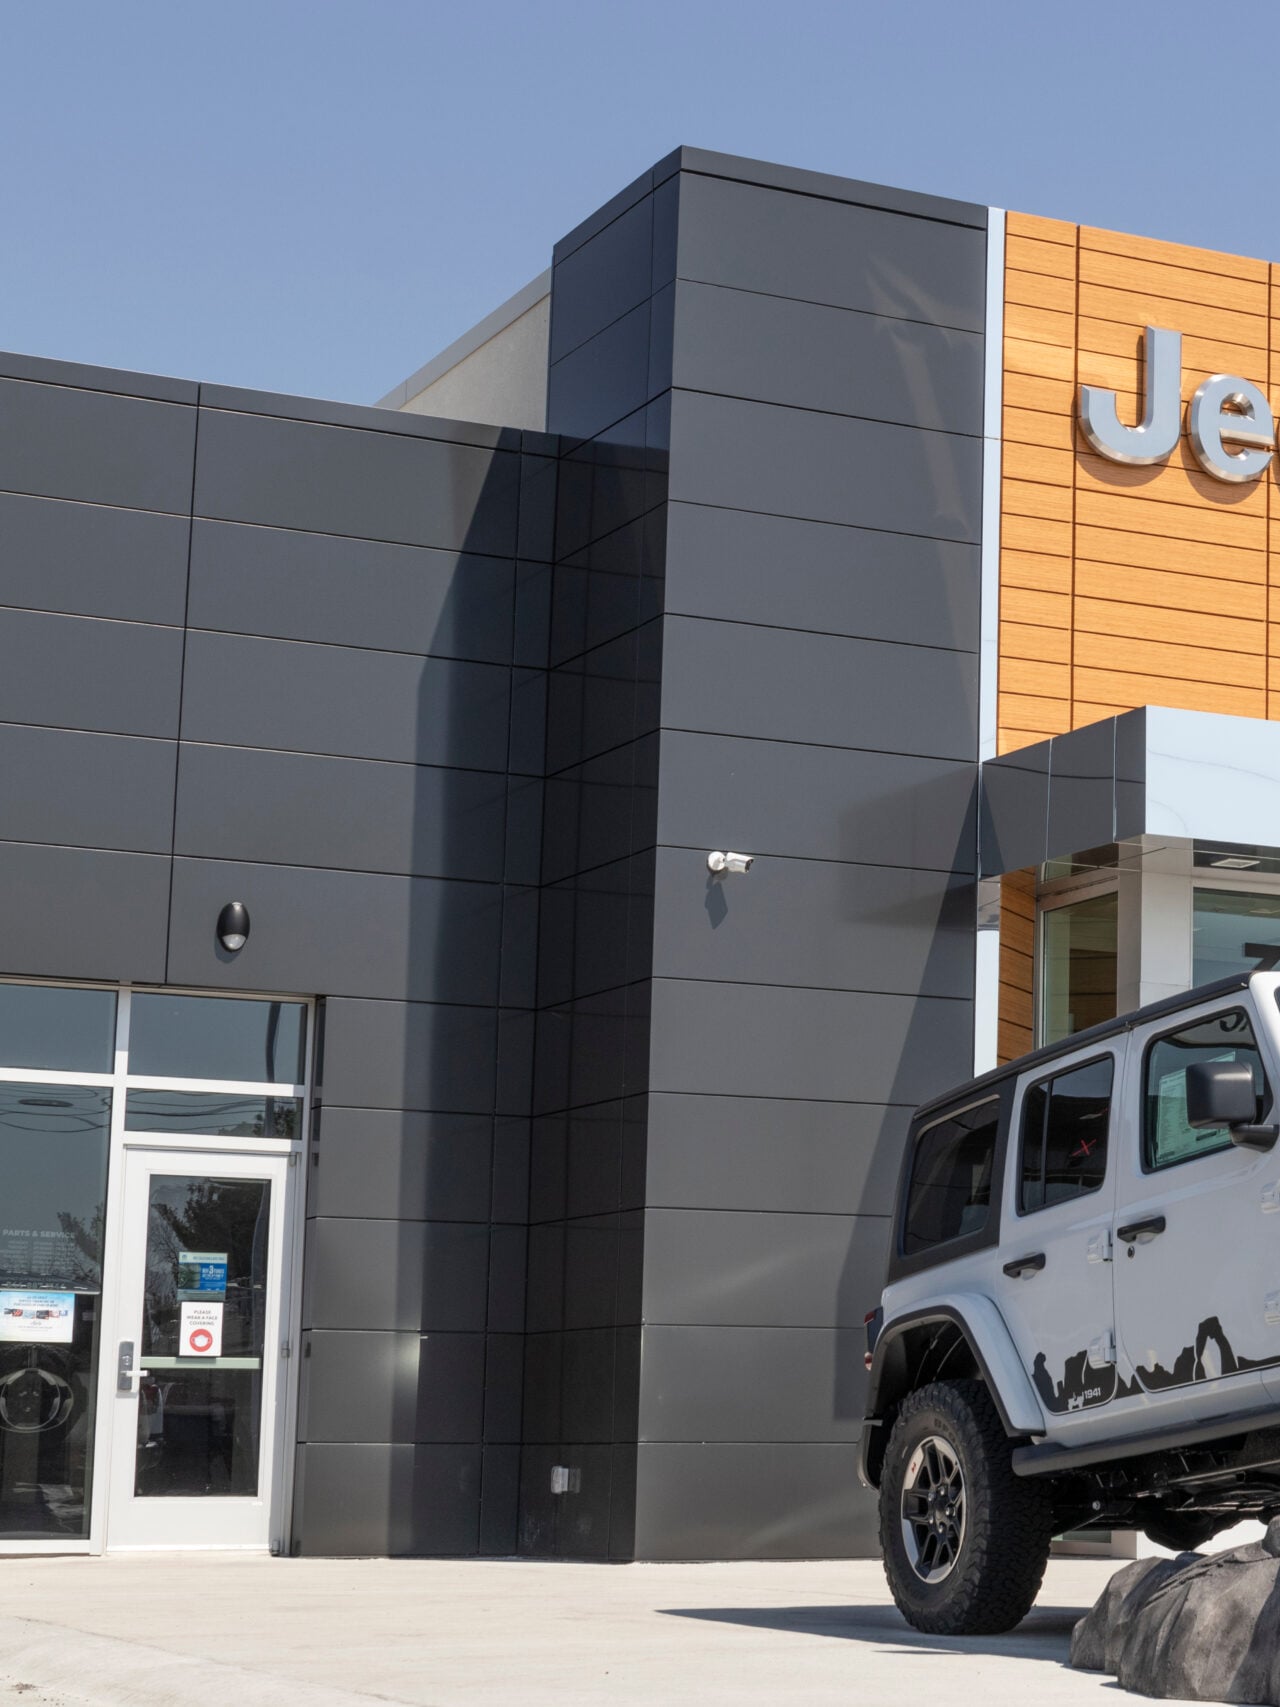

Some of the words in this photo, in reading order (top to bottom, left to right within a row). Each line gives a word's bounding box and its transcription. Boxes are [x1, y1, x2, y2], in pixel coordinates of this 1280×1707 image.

[2, 1229, 30, 1237] PARTS
[40, 1230, 75, 1239] SERVICE
[1084, 1387, 1101, 1399] 1941
